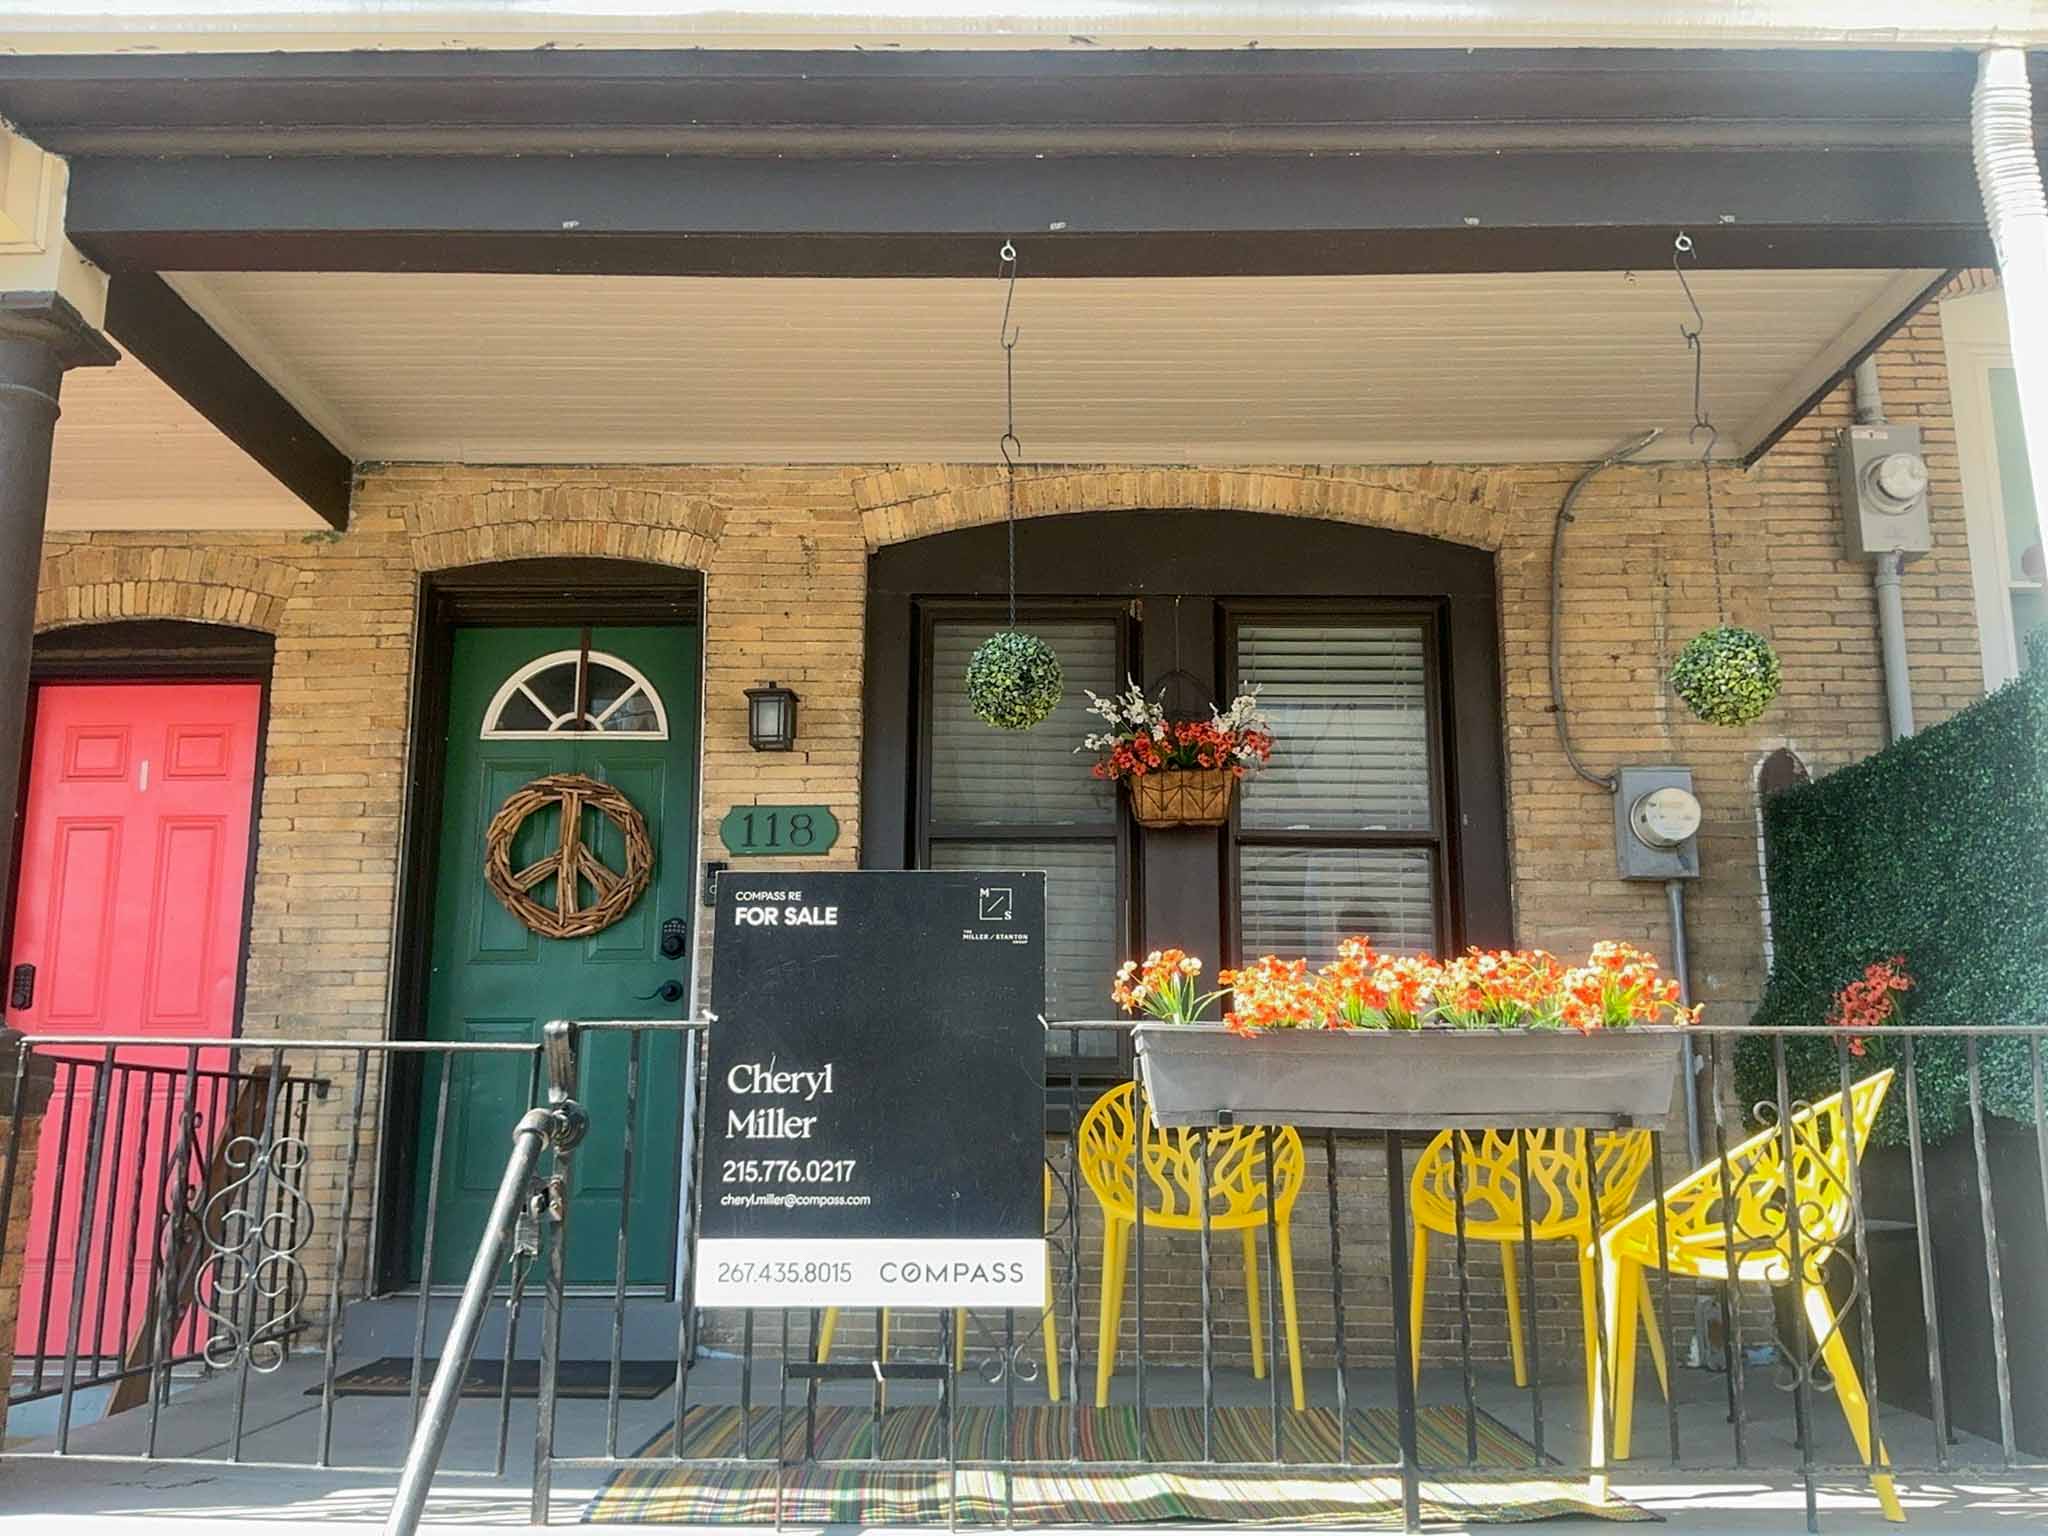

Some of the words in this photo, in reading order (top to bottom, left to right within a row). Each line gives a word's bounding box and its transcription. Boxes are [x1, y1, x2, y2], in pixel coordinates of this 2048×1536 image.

[741, 813, 814, 847] 118
[735, 891, 786, 901] COMPASS
[788, 891, 802, 901] RE
[980, 888, 990, 897] M
[735, 907, 778, 925] FOR
[784, 907, 838, 925] SALE
[1004, 911, 1012, 920] S
[728, 1064, 833, 1100] Cheryl
[725, 1108, 817, 1138] Miller
[722, 1160, 856, 1182] 215.776.0217
[720, 1193, 871, 1208] cheryl.miller@compass.com
[718, 1262, 851, 1283] 267.435.8015
[880, 1262, 1024, 1284] COMPASS
